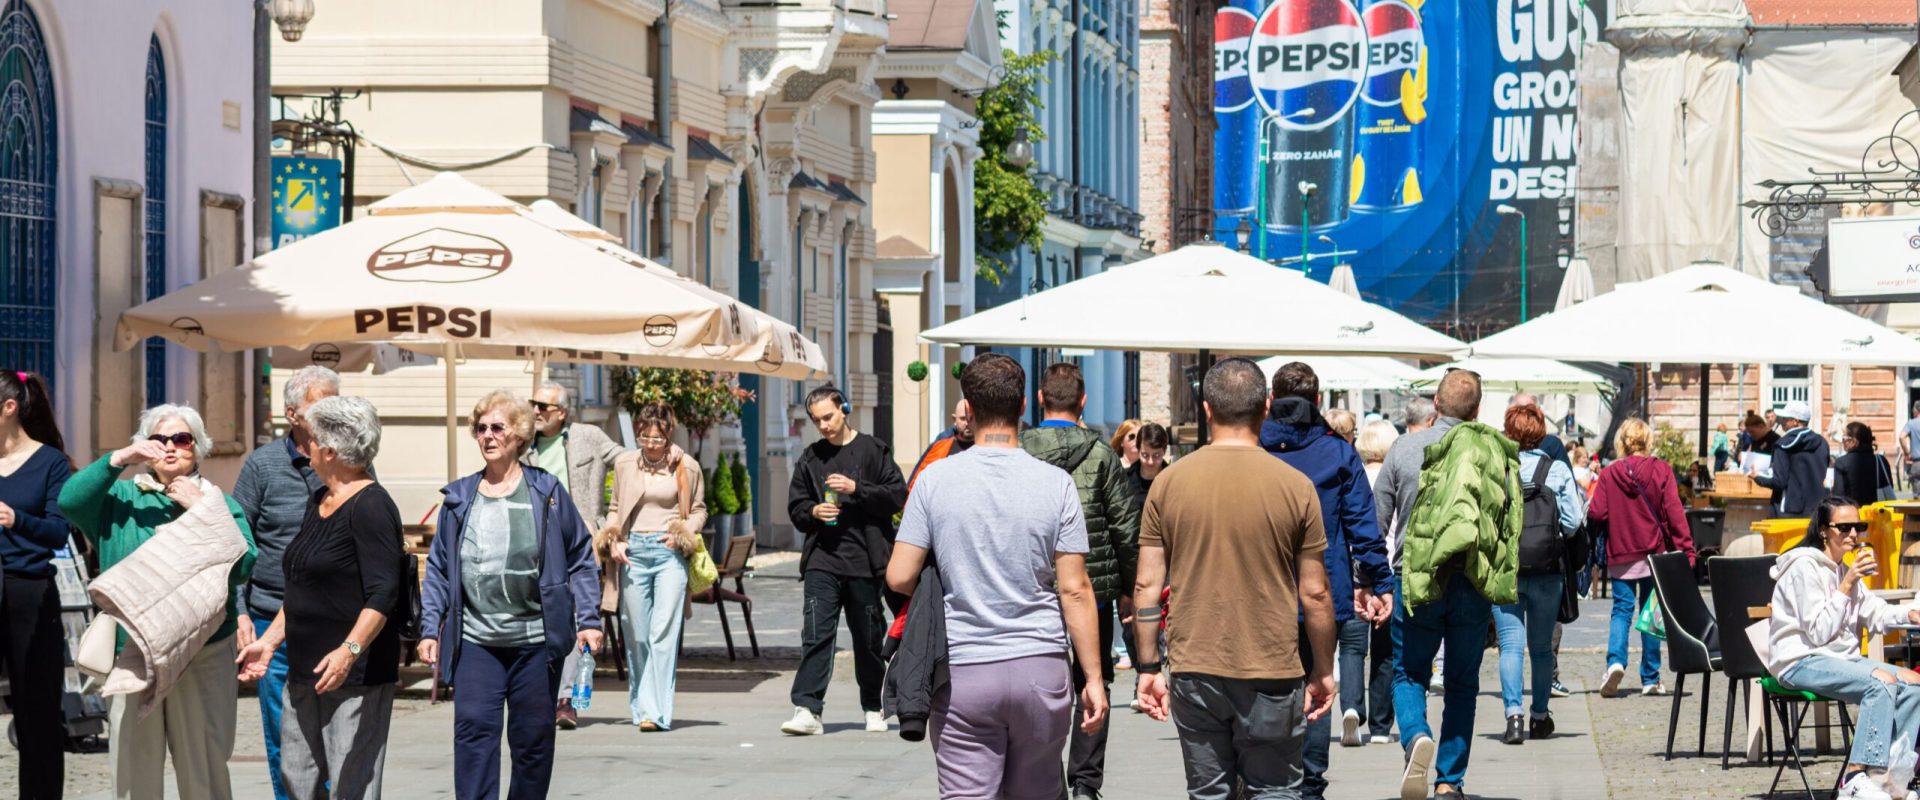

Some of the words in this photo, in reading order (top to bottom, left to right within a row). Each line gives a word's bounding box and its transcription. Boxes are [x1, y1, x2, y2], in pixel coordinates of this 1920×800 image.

[1496, 0, 1616, 62] GUS
[1257, 41, 1360, 73] PEPSI
[1492, 115, 1532, 163] UN
[1272, 151, 1302, 161] ZERO
[375, 248, 504, 268] PEPSI
[1877, 279, 1905, 288] energy
[354, 304, 492, 340] PEPSI
[644, 325, 676, 335] PEPSI
